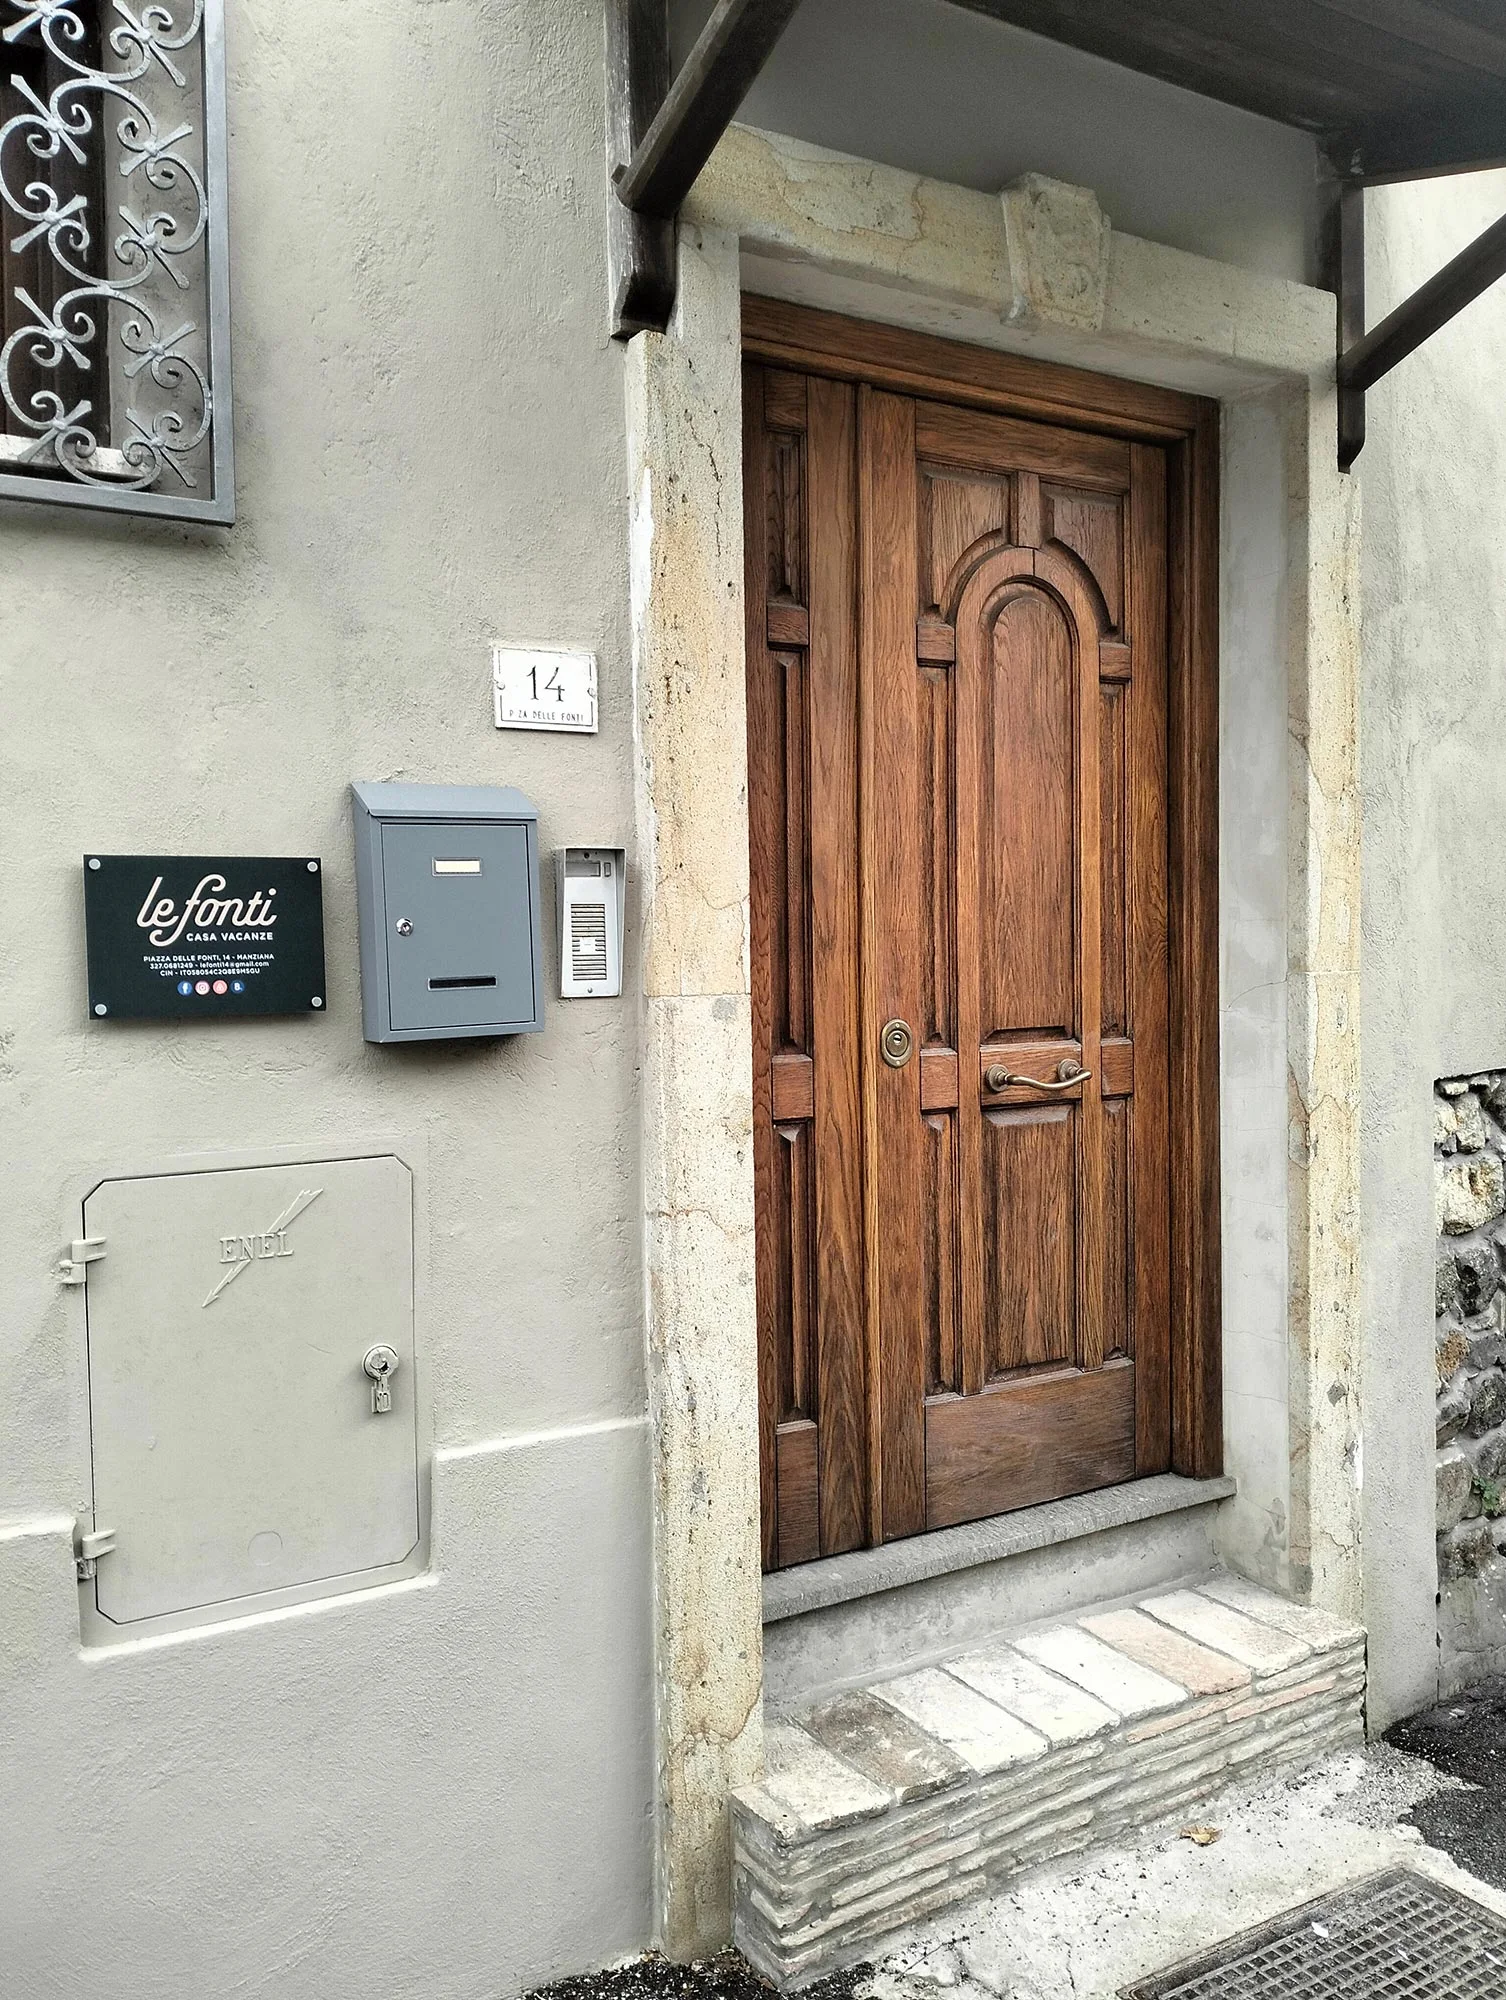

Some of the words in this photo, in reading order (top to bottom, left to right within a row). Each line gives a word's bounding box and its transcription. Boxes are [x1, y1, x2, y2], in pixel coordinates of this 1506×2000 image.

[526, 665, 565, 702] 14
[533, 711, 556, 720] DELLE
[561, 713, 584, 722] FONTI
[186, 932, 217, 941] CASA
[221, 932, 274, 941] VACANZE
[219, 1231, 295, 1264] ENEL
